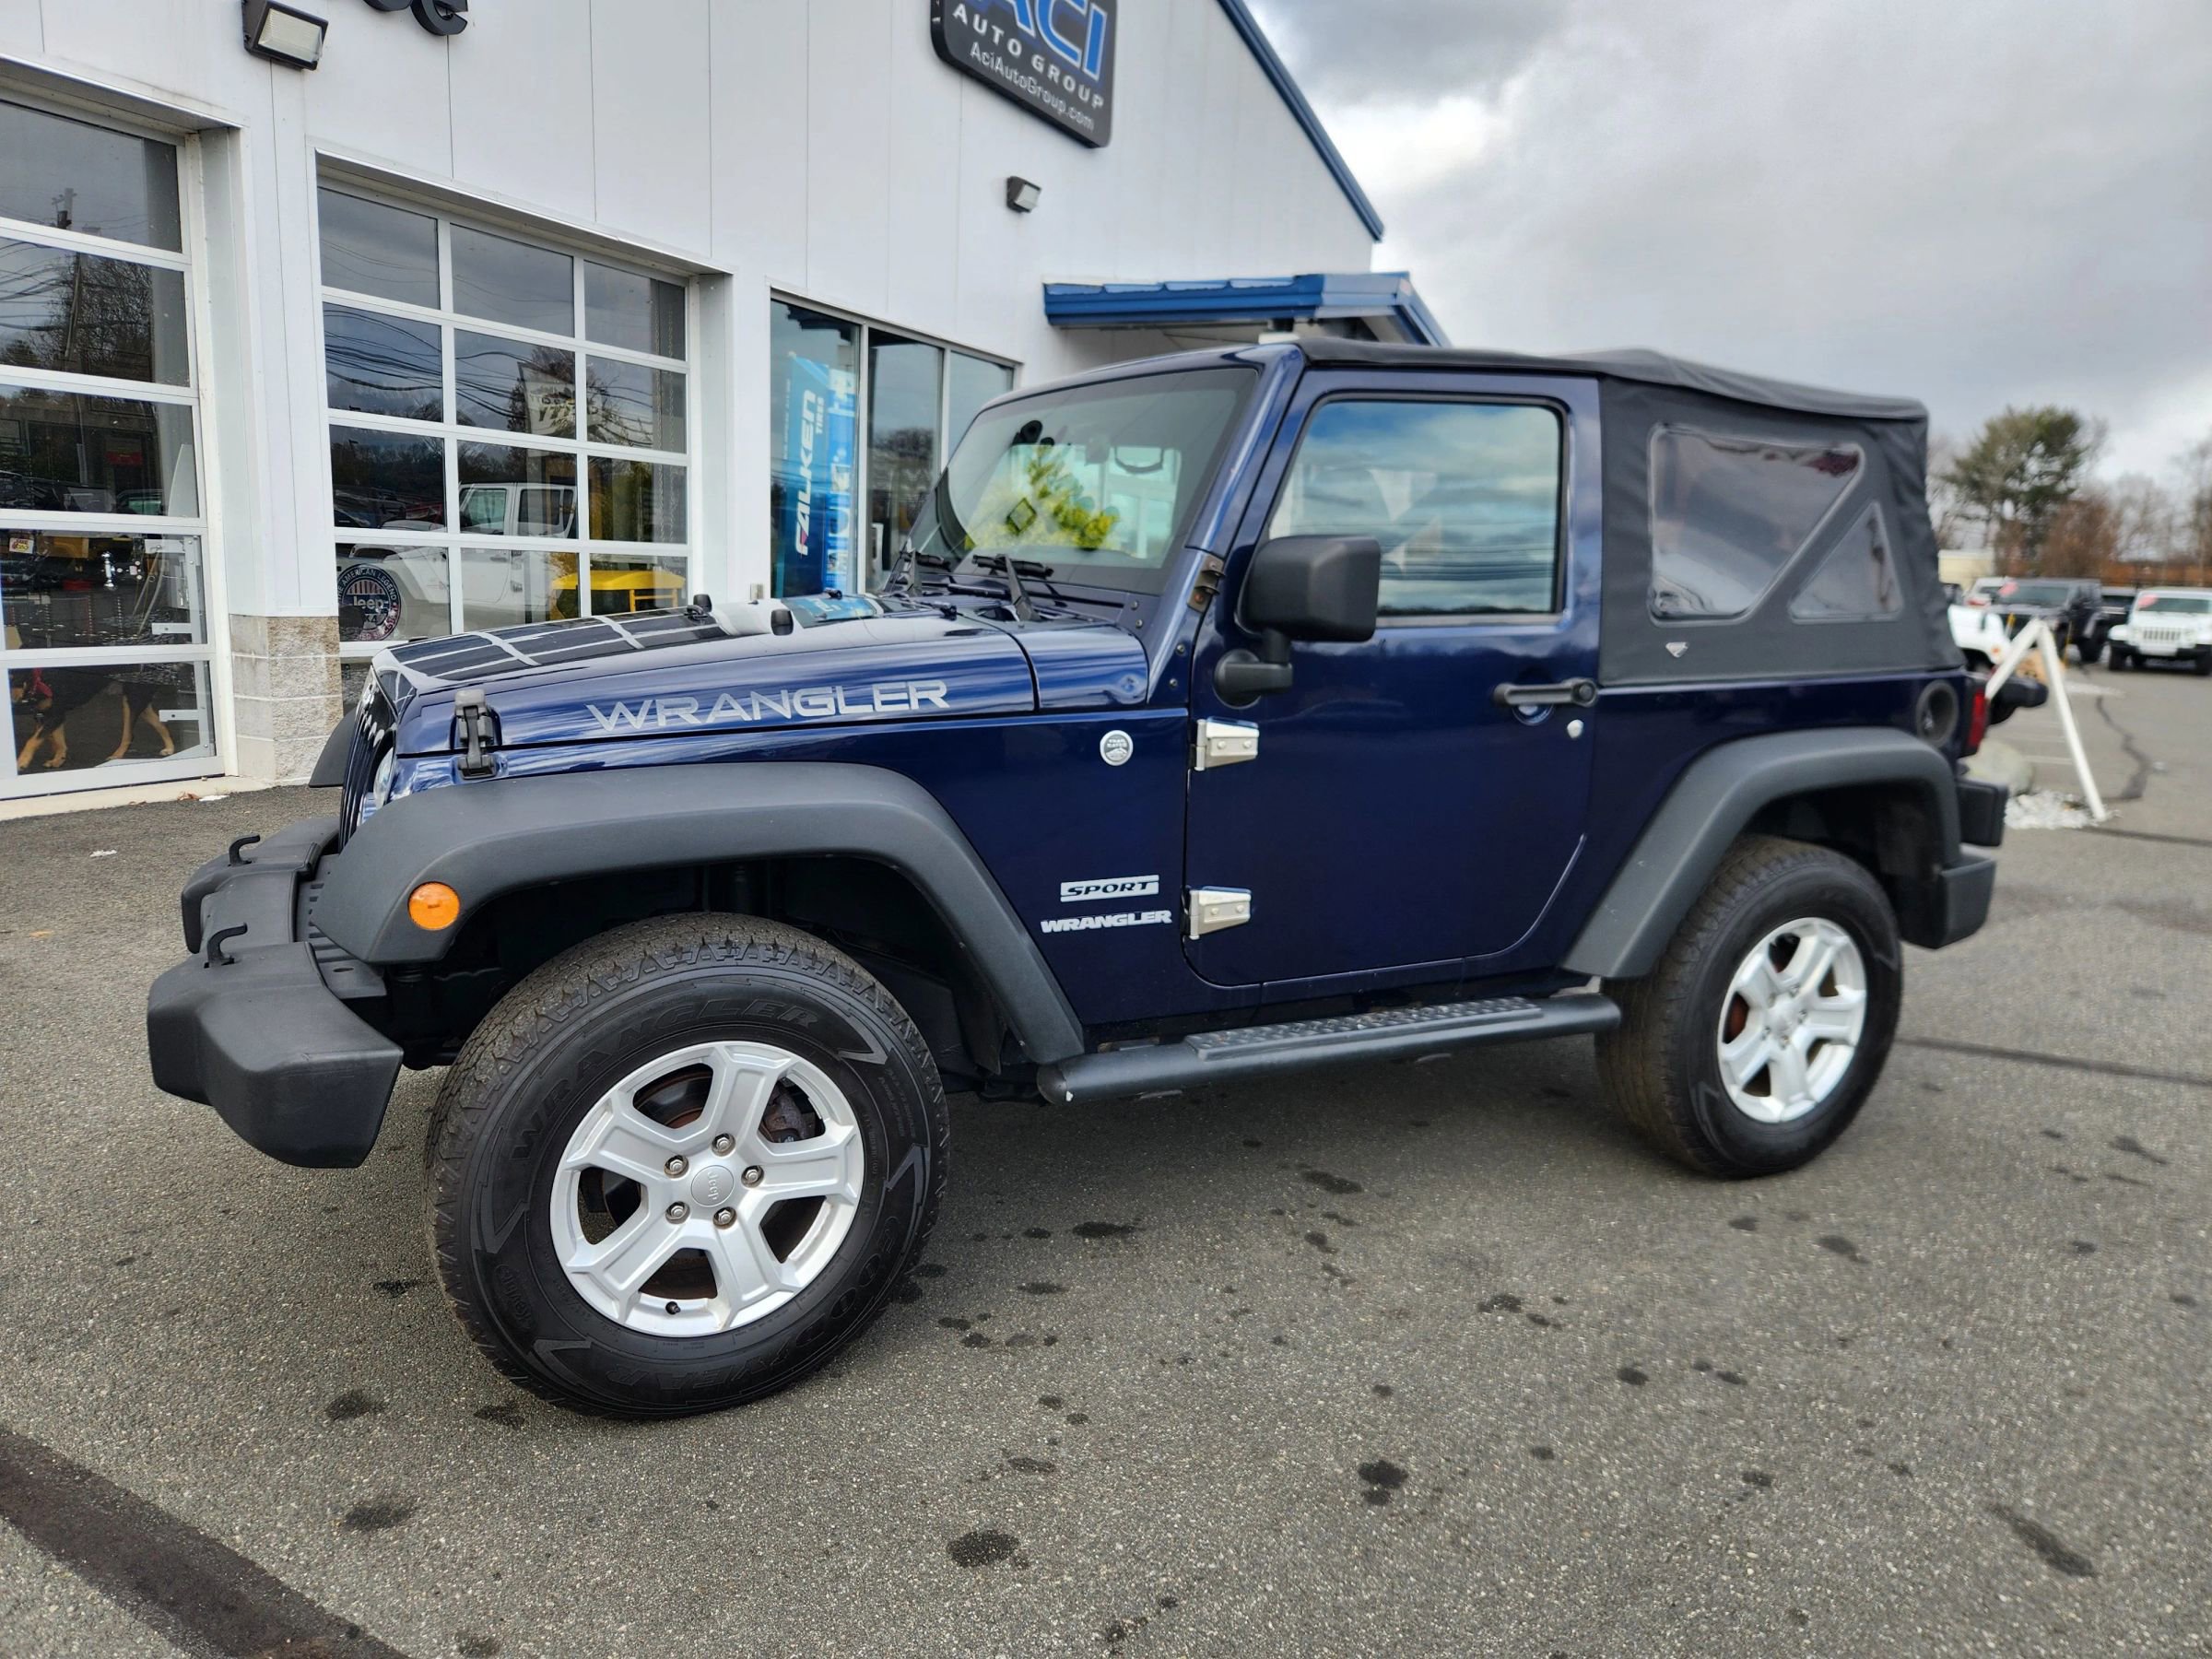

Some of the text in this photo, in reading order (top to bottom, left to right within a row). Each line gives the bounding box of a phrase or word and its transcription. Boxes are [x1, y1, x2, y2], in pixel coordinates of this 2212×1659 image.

[952, 3, 1105, 109] AUTO GROUP
[970, 41, 1095, 133] AciAutoGroup.com
[815, 396, 825, 434] TIRES
[342, 566, 377, 586] AMERICAN
[377, 571, 397, 600] LEGEND
[584, 679, 950, 732] WRANGLER
[1063, 880, 1158, 898] SPORT
[1041, 910, 1172, 933] WRANGLER
[509, 998, 820, 1160] WRANGLER
[708, 1171, 719, 1200] Jeep
[606, 1216, 901, 1391] GOODYEAR
